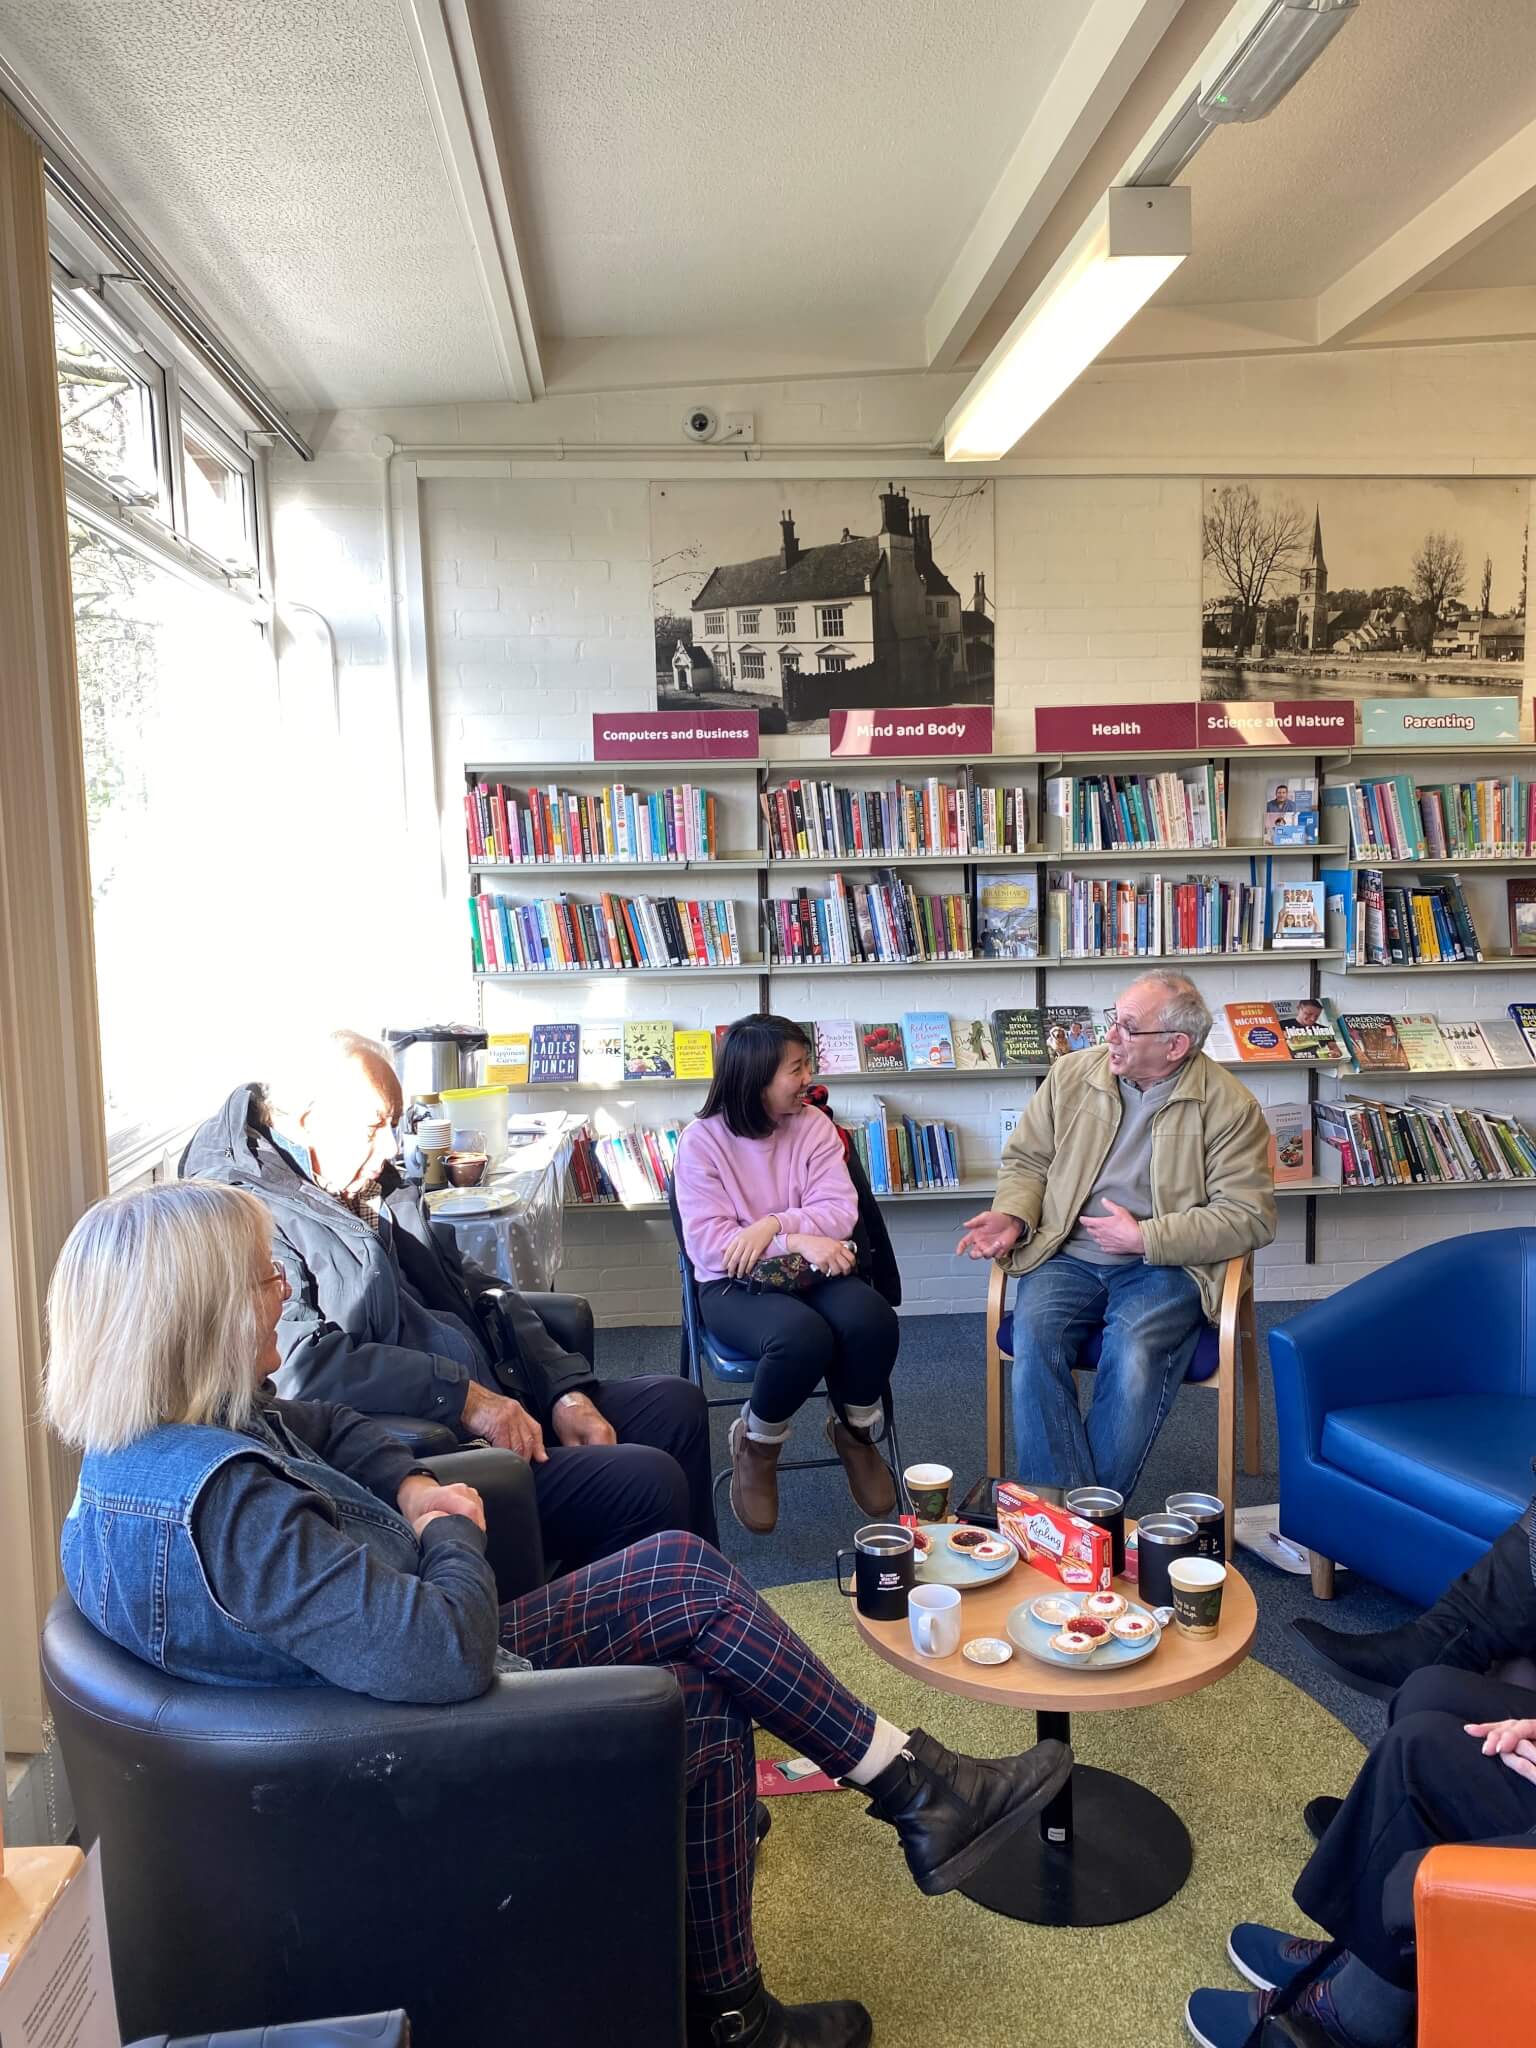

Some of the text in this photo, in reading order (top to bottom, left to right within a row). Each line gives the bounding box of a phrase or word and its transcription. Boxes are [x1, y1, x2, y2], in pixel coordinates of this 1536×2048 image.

[1092, 722, 1141, 736] Health
[1207, 714, 1345, 729] Science and Nature
[1404, 714, 1476, 730] Parenting
[602, 728, 750, 743] Computers and Business
[857, 722, 966, 738] Mind and Body
[1047, 1008, 1078, 1016] NIGEL
[630, 1024, 668, 1032] WITCH
[534, 1041, 576, 1055] LADIES
[1008, 1041, 1038, 1050] patrick
[533, 1059, 575, 1076] PUNCH
[1029, 1520, 1062, 1550] Kipling
